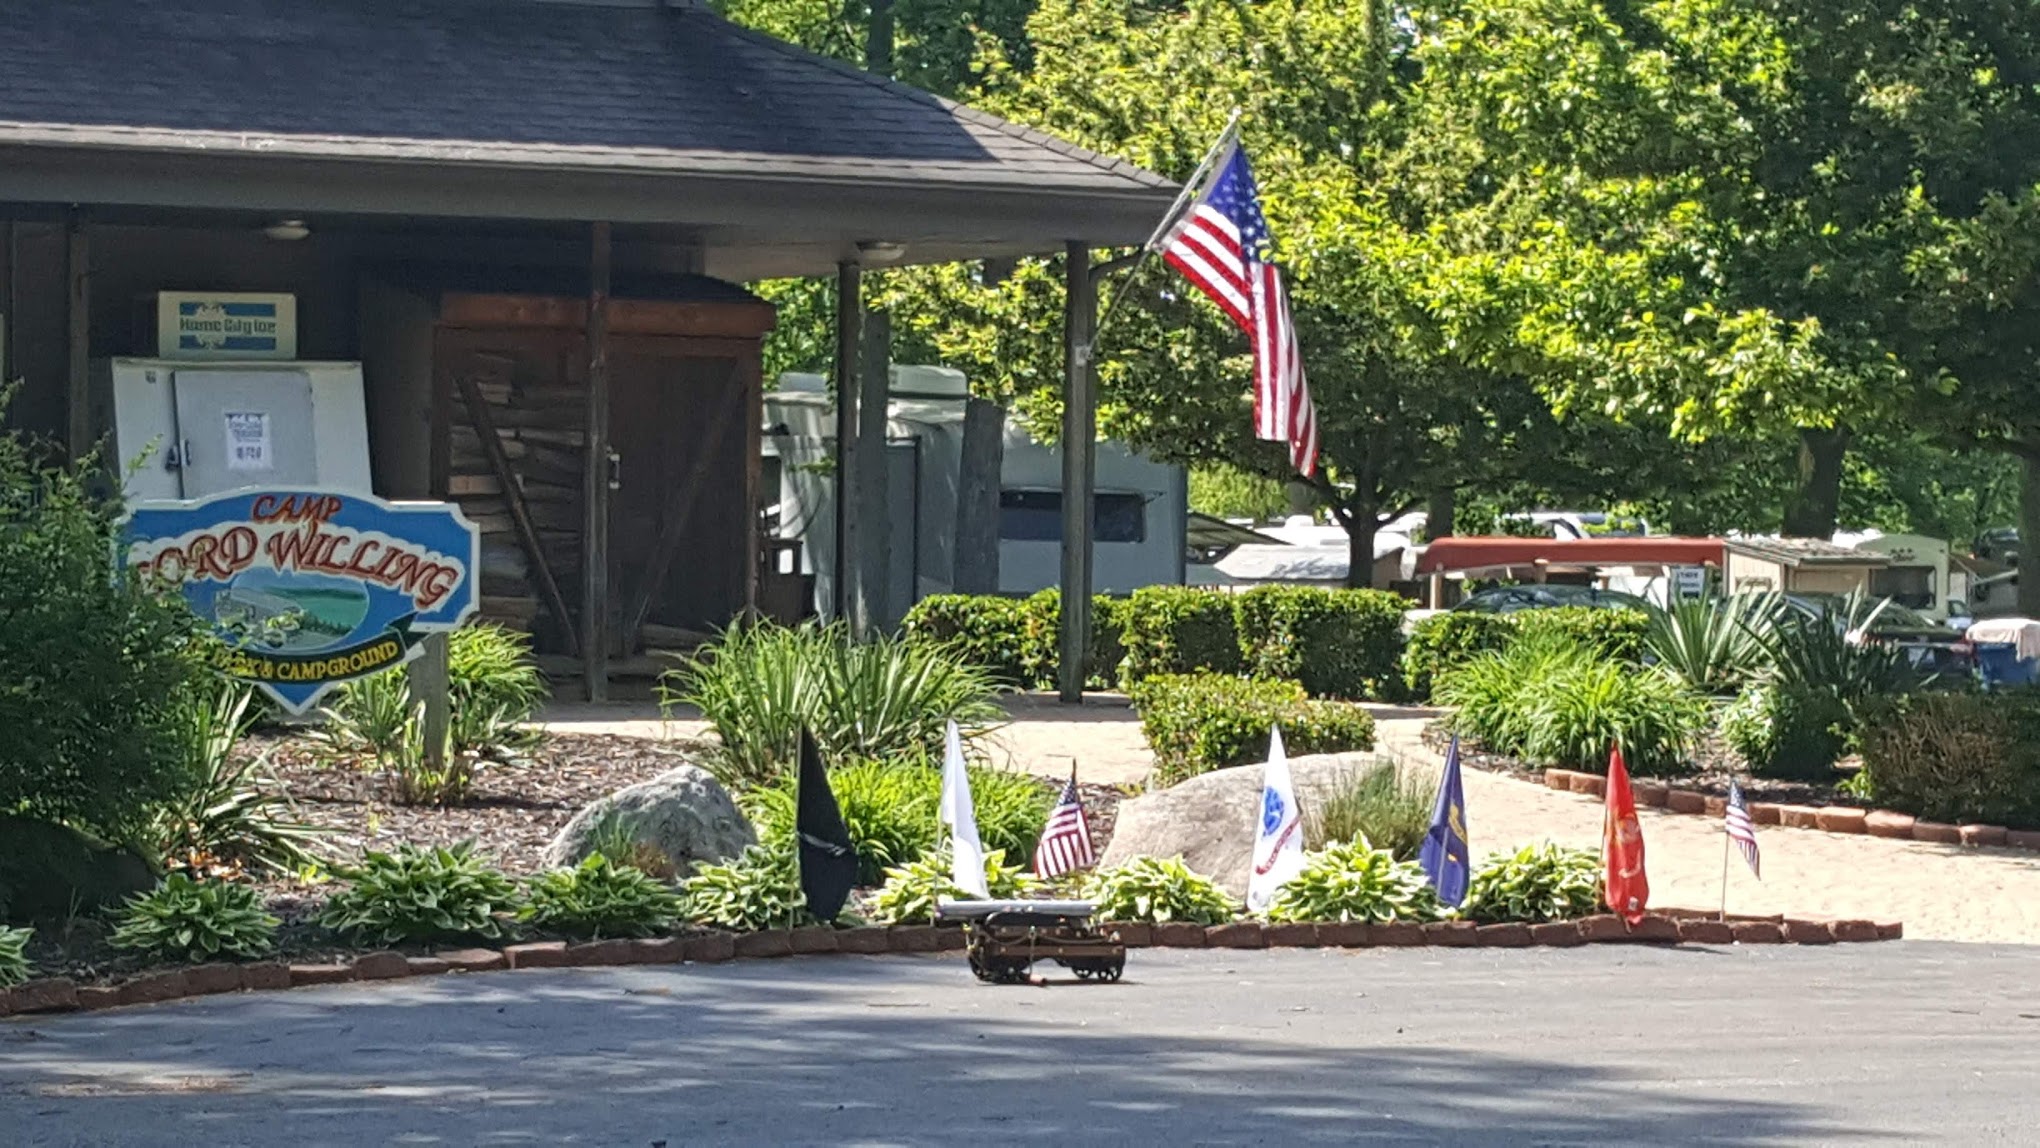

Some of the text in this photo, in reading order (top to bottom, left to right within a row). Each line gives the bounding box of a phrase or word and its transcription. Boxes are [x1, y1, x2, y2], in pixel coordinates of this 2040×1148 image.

[180, 318, 221, 332] Home
[253, 494, 342, 523] CAMP
[137, 519, 459, 609] ORD WILLING
[261, 659, 273, 679] &
[277, 640, 398, 680] CAMPGROUND
